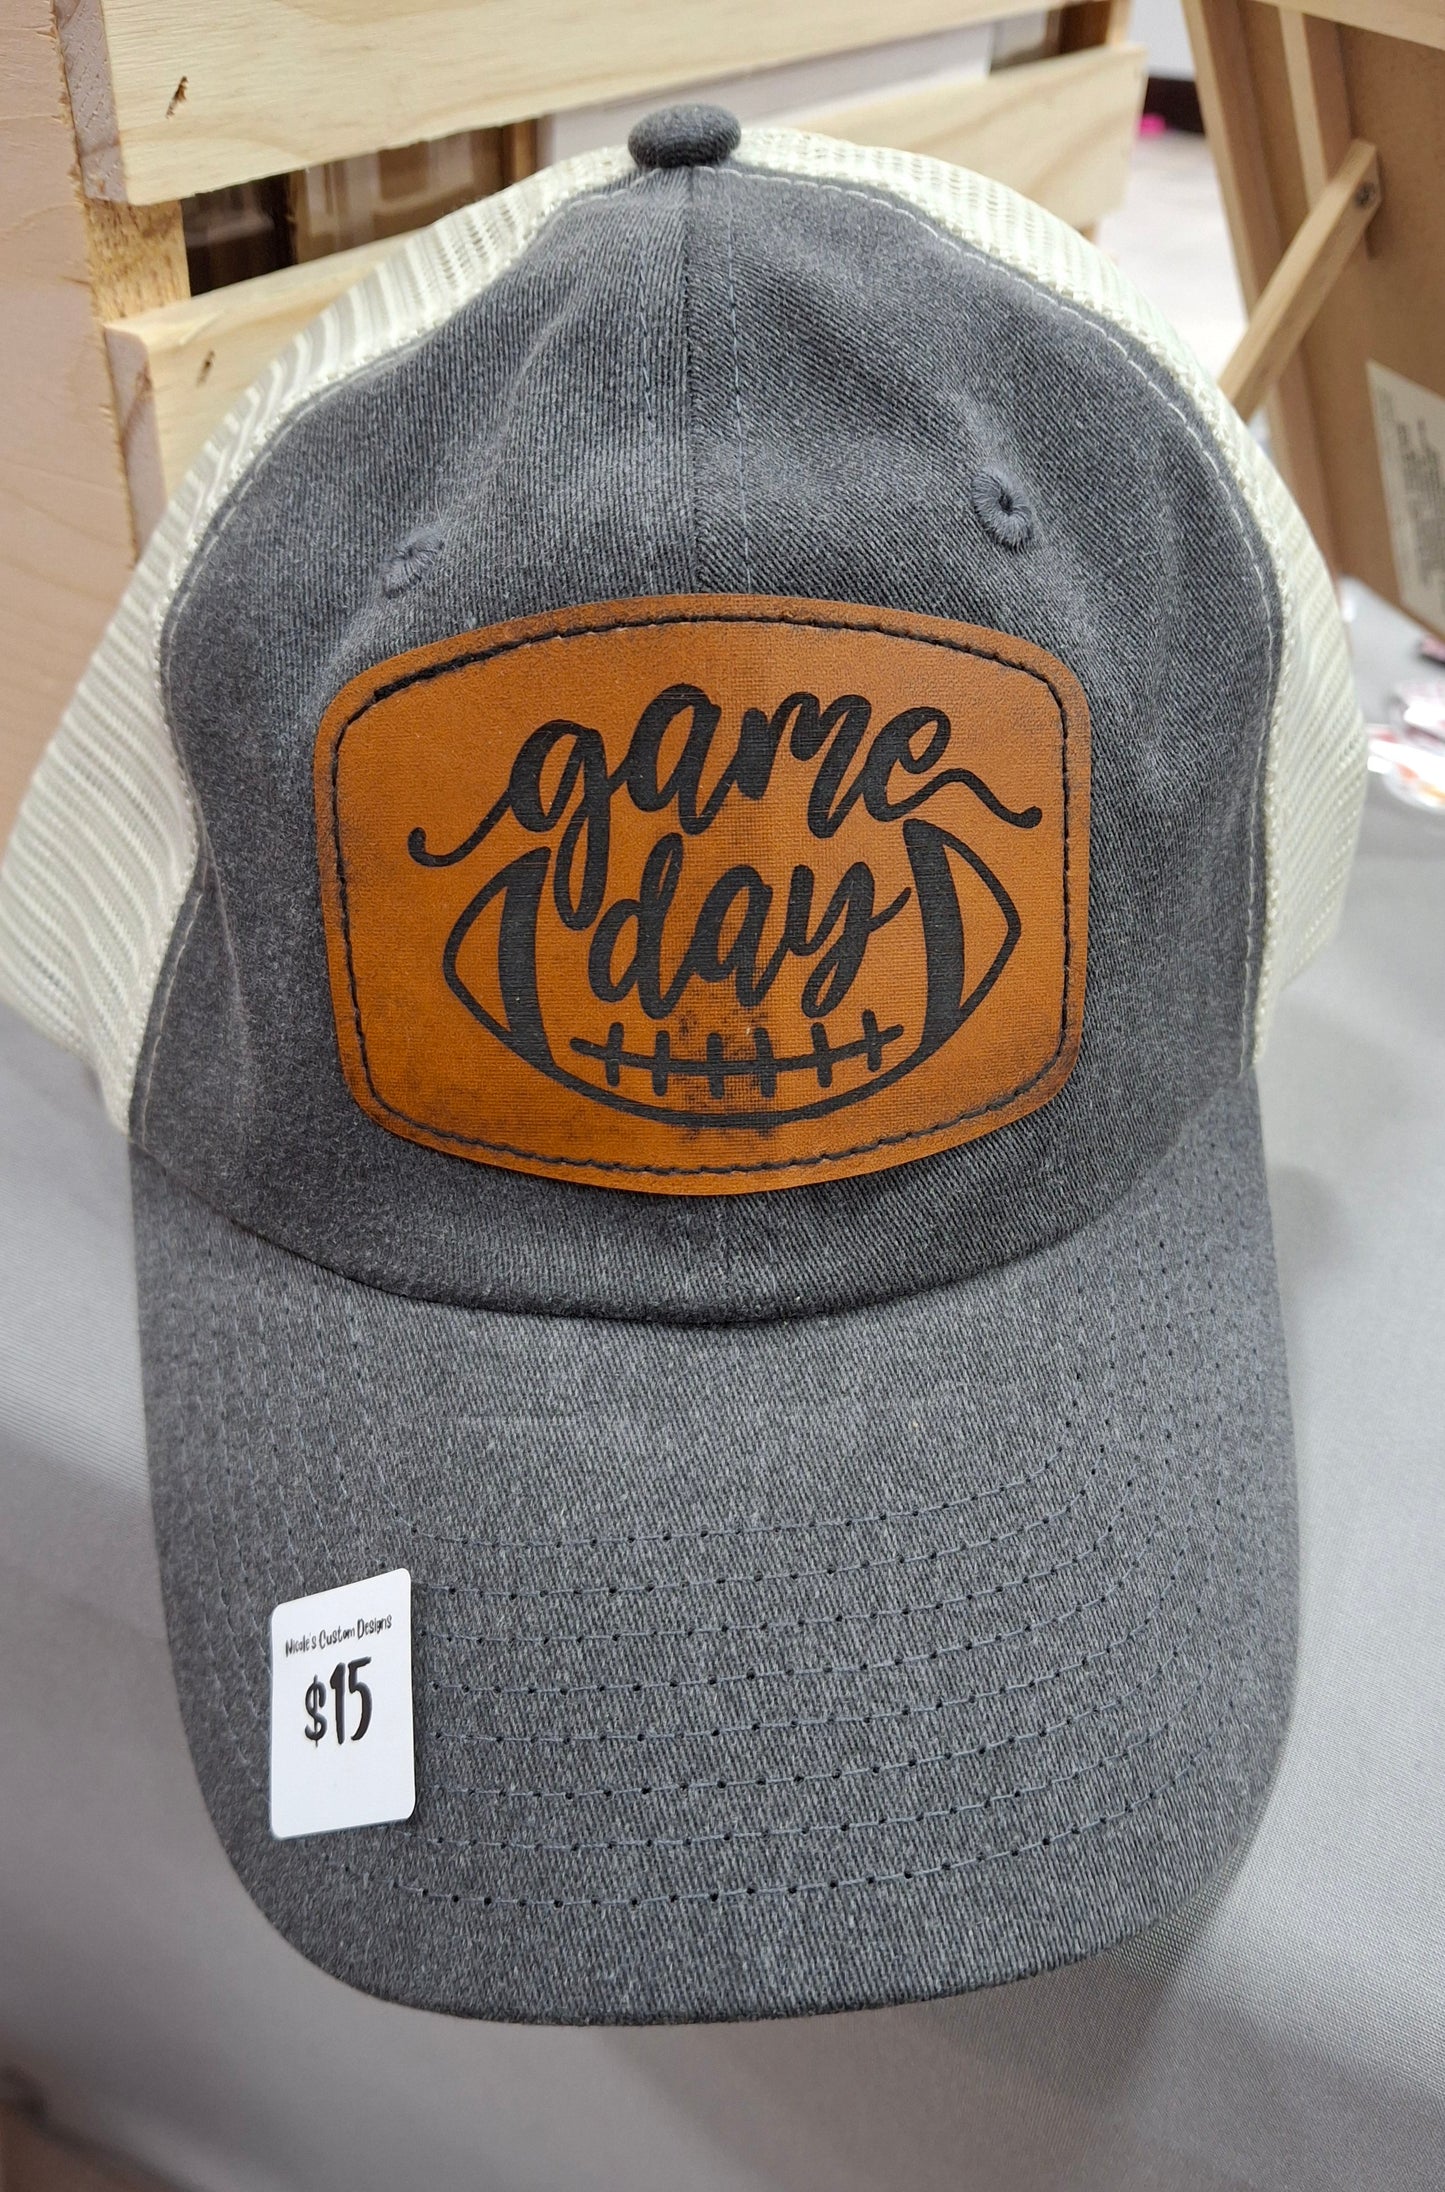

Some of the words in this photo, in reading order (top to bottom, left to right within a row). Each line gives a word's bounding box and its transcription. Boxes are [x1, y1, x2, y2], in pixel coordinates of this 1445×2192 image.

[408, 682, 1043, 930] game
[587, 832, 912, 1019] day
[285, 1632, 317, 1657] Nicole's
[318, 1625, 355, 1650] Custom
[357, 1614, 392, 1640] Designs
[304, 1656, 373, 1748] $15
